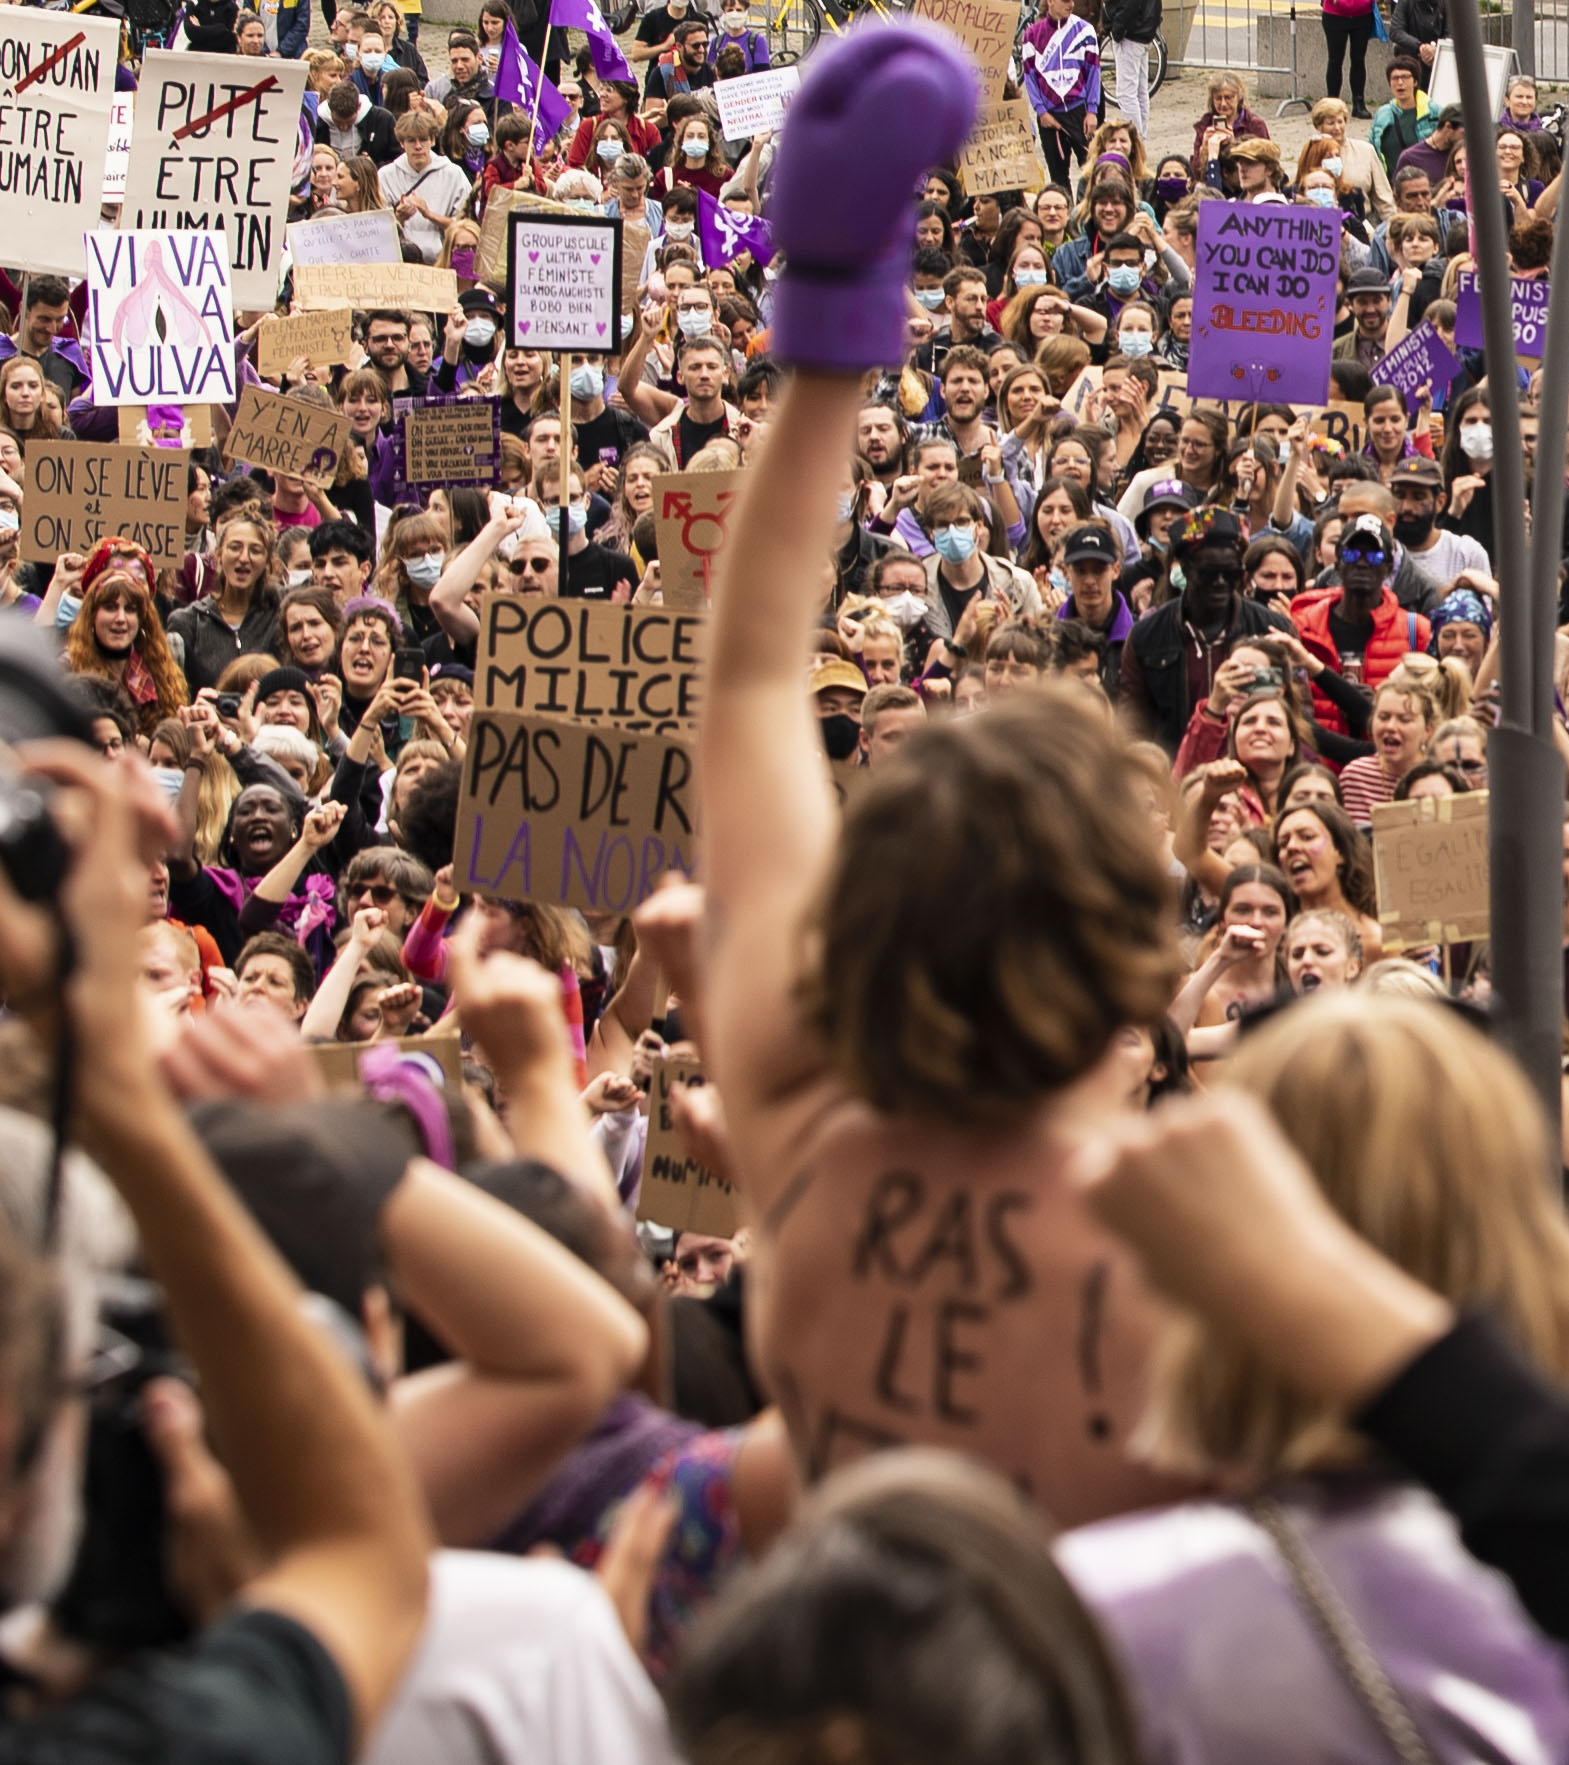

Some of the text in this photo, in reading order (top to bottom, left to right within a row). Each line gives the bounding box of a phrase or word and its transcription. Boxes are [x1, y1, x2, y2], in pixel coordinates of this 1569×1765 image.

[0, 38, 99, 92] ON JUAN
[157, 75, 284, 144] PUTE
[723, 97, 758, 109] GENDER
[0, 151, 82, 203] UMAIN
[155, 140, 276, 206] ÊTRE
[965, 149, 986, 166] LA
[522, 233, 608, 251] GROUPUSCULE
[1217, 212, 1333, 248] ANYTHING
[90, 235, 226, 288] VIVA
[546, 252, 582, 264] ULTRA
[1204, 243, 1336, 276] YOU CAN DO
[520, 284, 605, 299] ISLAMOGAUCHISTE
[531, 300, 593, 314] BOBO BIEN
[1212, 271, 1310, 299] I CAN DO
[535, 320, 589, 335] PENSANT
[1209, 304, 1321, 340] BLEEDING
[96, 344, 233, 397] VULVA
[1372, 323, 1434, 387] FEMINISTE
[1400, 357, 1434, 395] 2012
[251, 396, 338, 449] Y'EN A
[230, 427, 303, 472] MARRE
[36, 451, 183, 502] ON SE LÈVE
[84, 499, 103, 514] et
[34, 515, 72, 551] ON
[80, 519, 107, 551] SE
[488, 600, 706, 666] POLICE
[486, 664, 702, 719] MILICE
[470, 720, 693, 836] PAS DE R
[468, 813, 531, 894] LA
[852, 1167, 1033, 1300] RAS
[873, 1301, 991, 1429] LE
